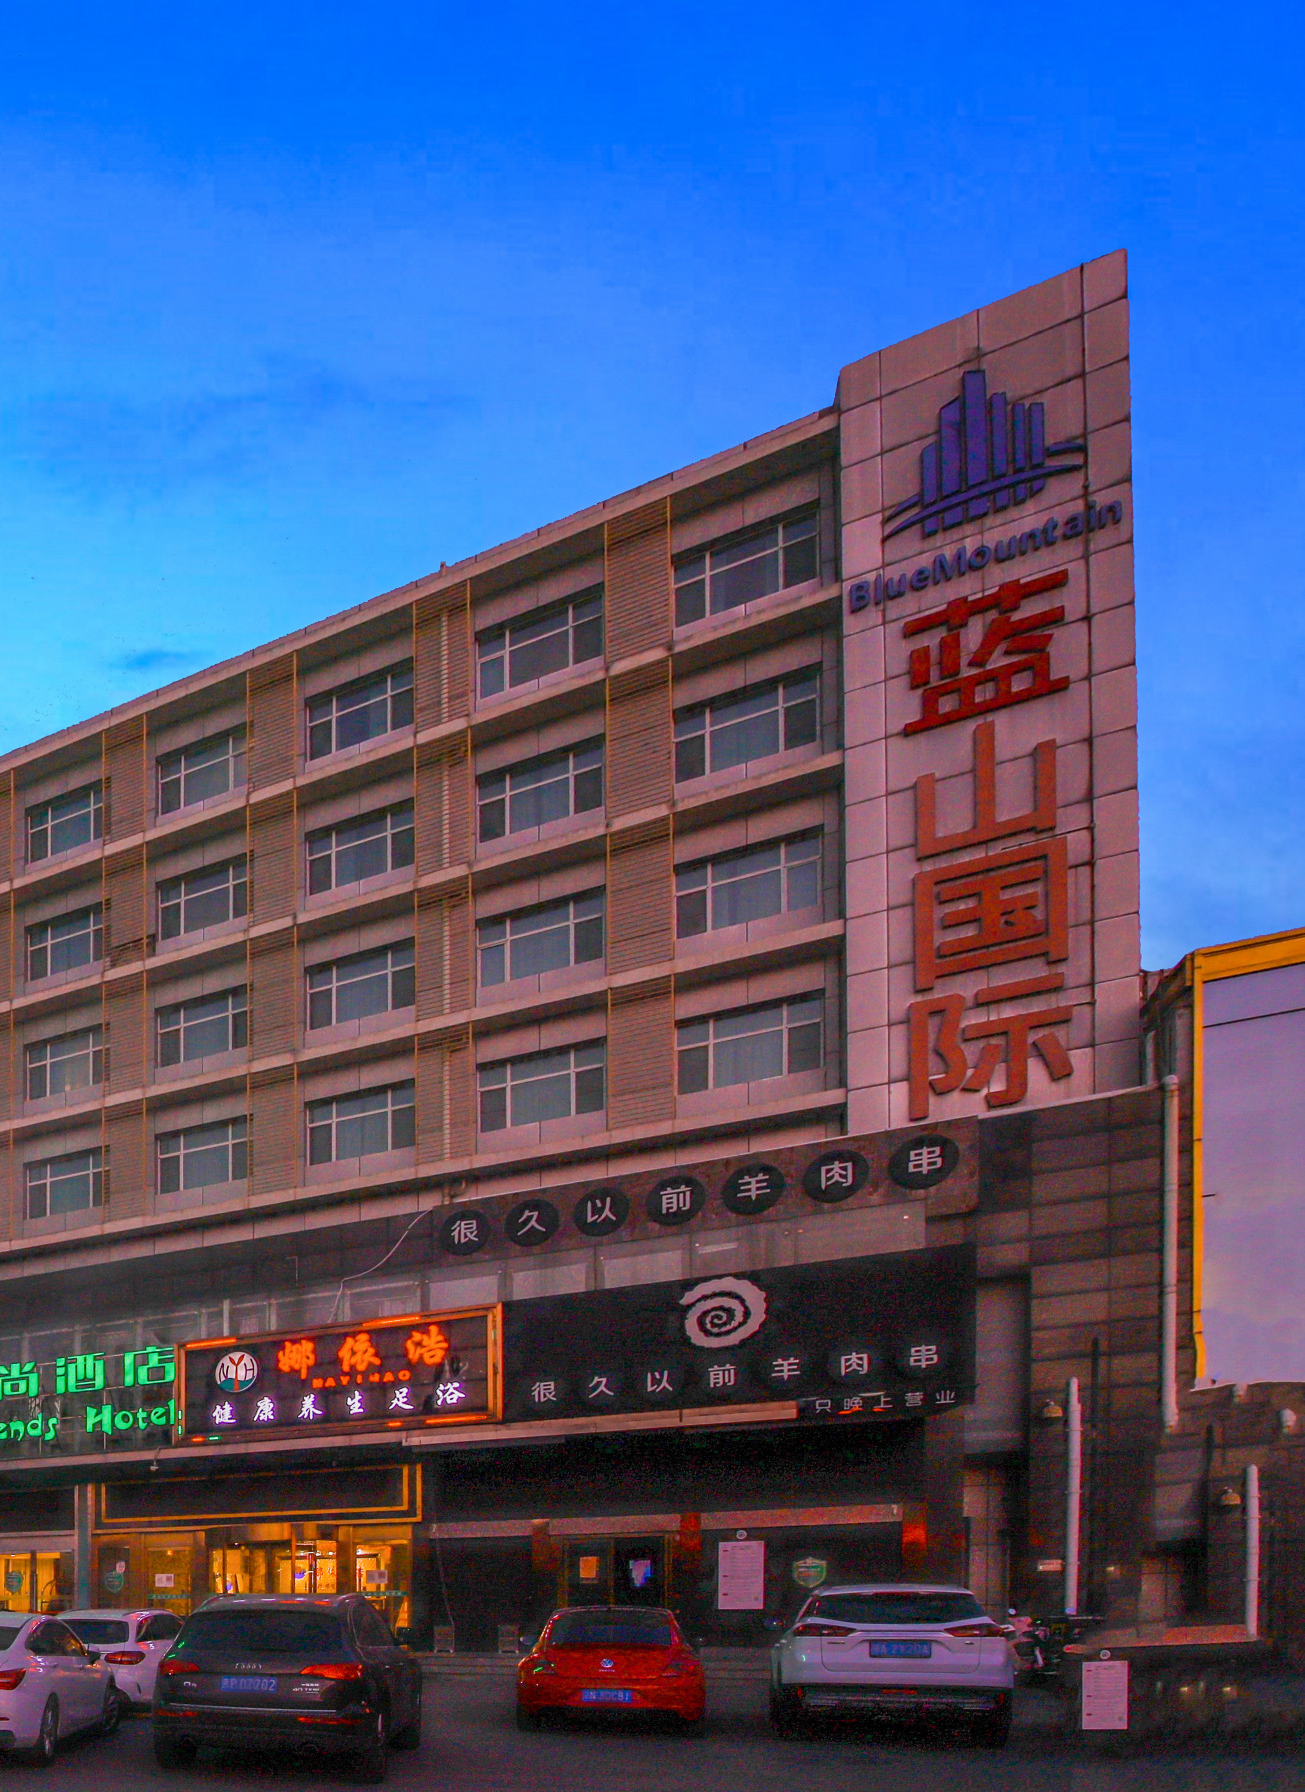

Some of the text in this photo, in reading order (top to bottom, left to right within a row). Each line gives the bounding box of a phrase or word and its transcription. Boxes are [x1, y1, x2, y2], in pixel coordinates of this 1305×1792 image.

[848, 498, 1123, 613] BlueMountain
[903, 569, 1075, 1120] 蓝山国际
[450, 1145, 943, 1244] 很久以前羊肉串
[212, 1382, 466, 1426] 健康养生足浴
[531, 1344, 939, 1402] 很久以前羊肉串
[85, 1399, 176, 1436] Hotel
